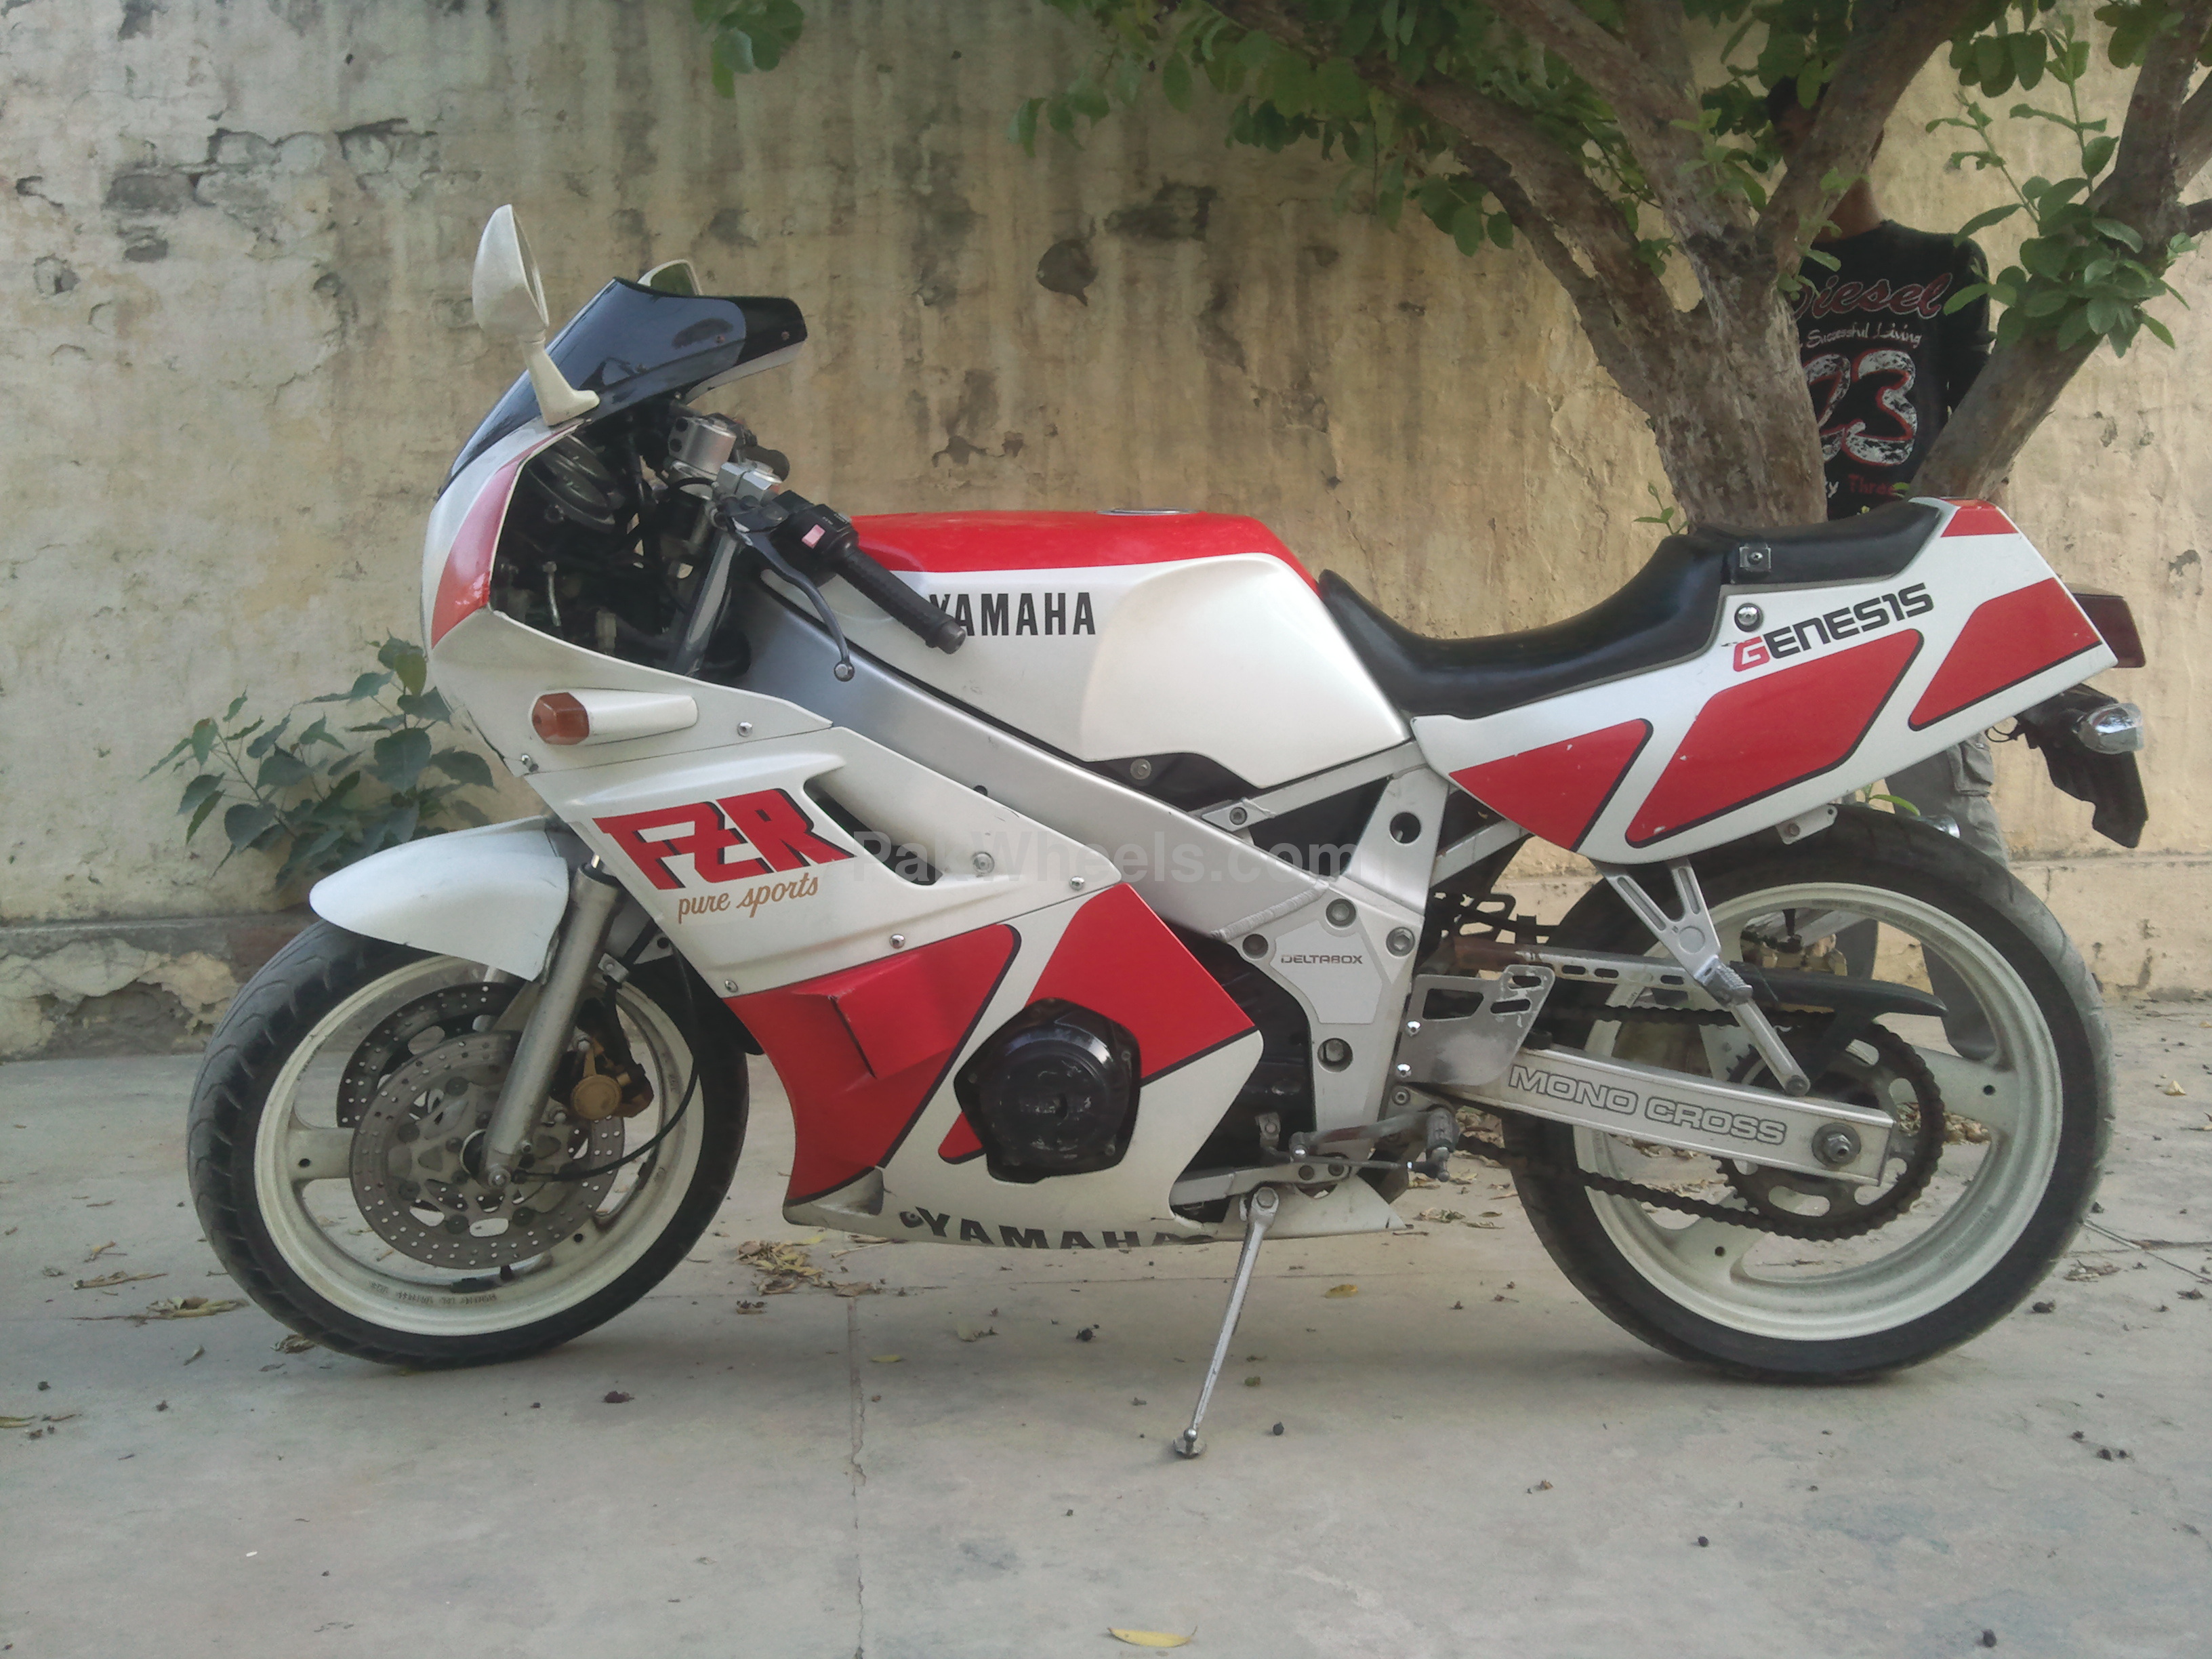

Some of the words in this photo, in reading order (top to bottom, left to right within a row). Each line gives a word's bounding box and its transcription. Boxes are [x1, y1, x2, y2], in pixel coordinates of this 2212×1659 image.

[1872, 323, 1922, 348] Living
[1733, 582, 1934, 672] GENESIS
[592, 788, 857, 890] FZR
[678, 892, 731, 924] pure
[736, 872, 819, 918] sports
[1281, 954, 1363, 965] DELTABOX
[1509, 1065, 1639, 1115] MONO
[1645, 1097, 1786, 1145] CROSS
